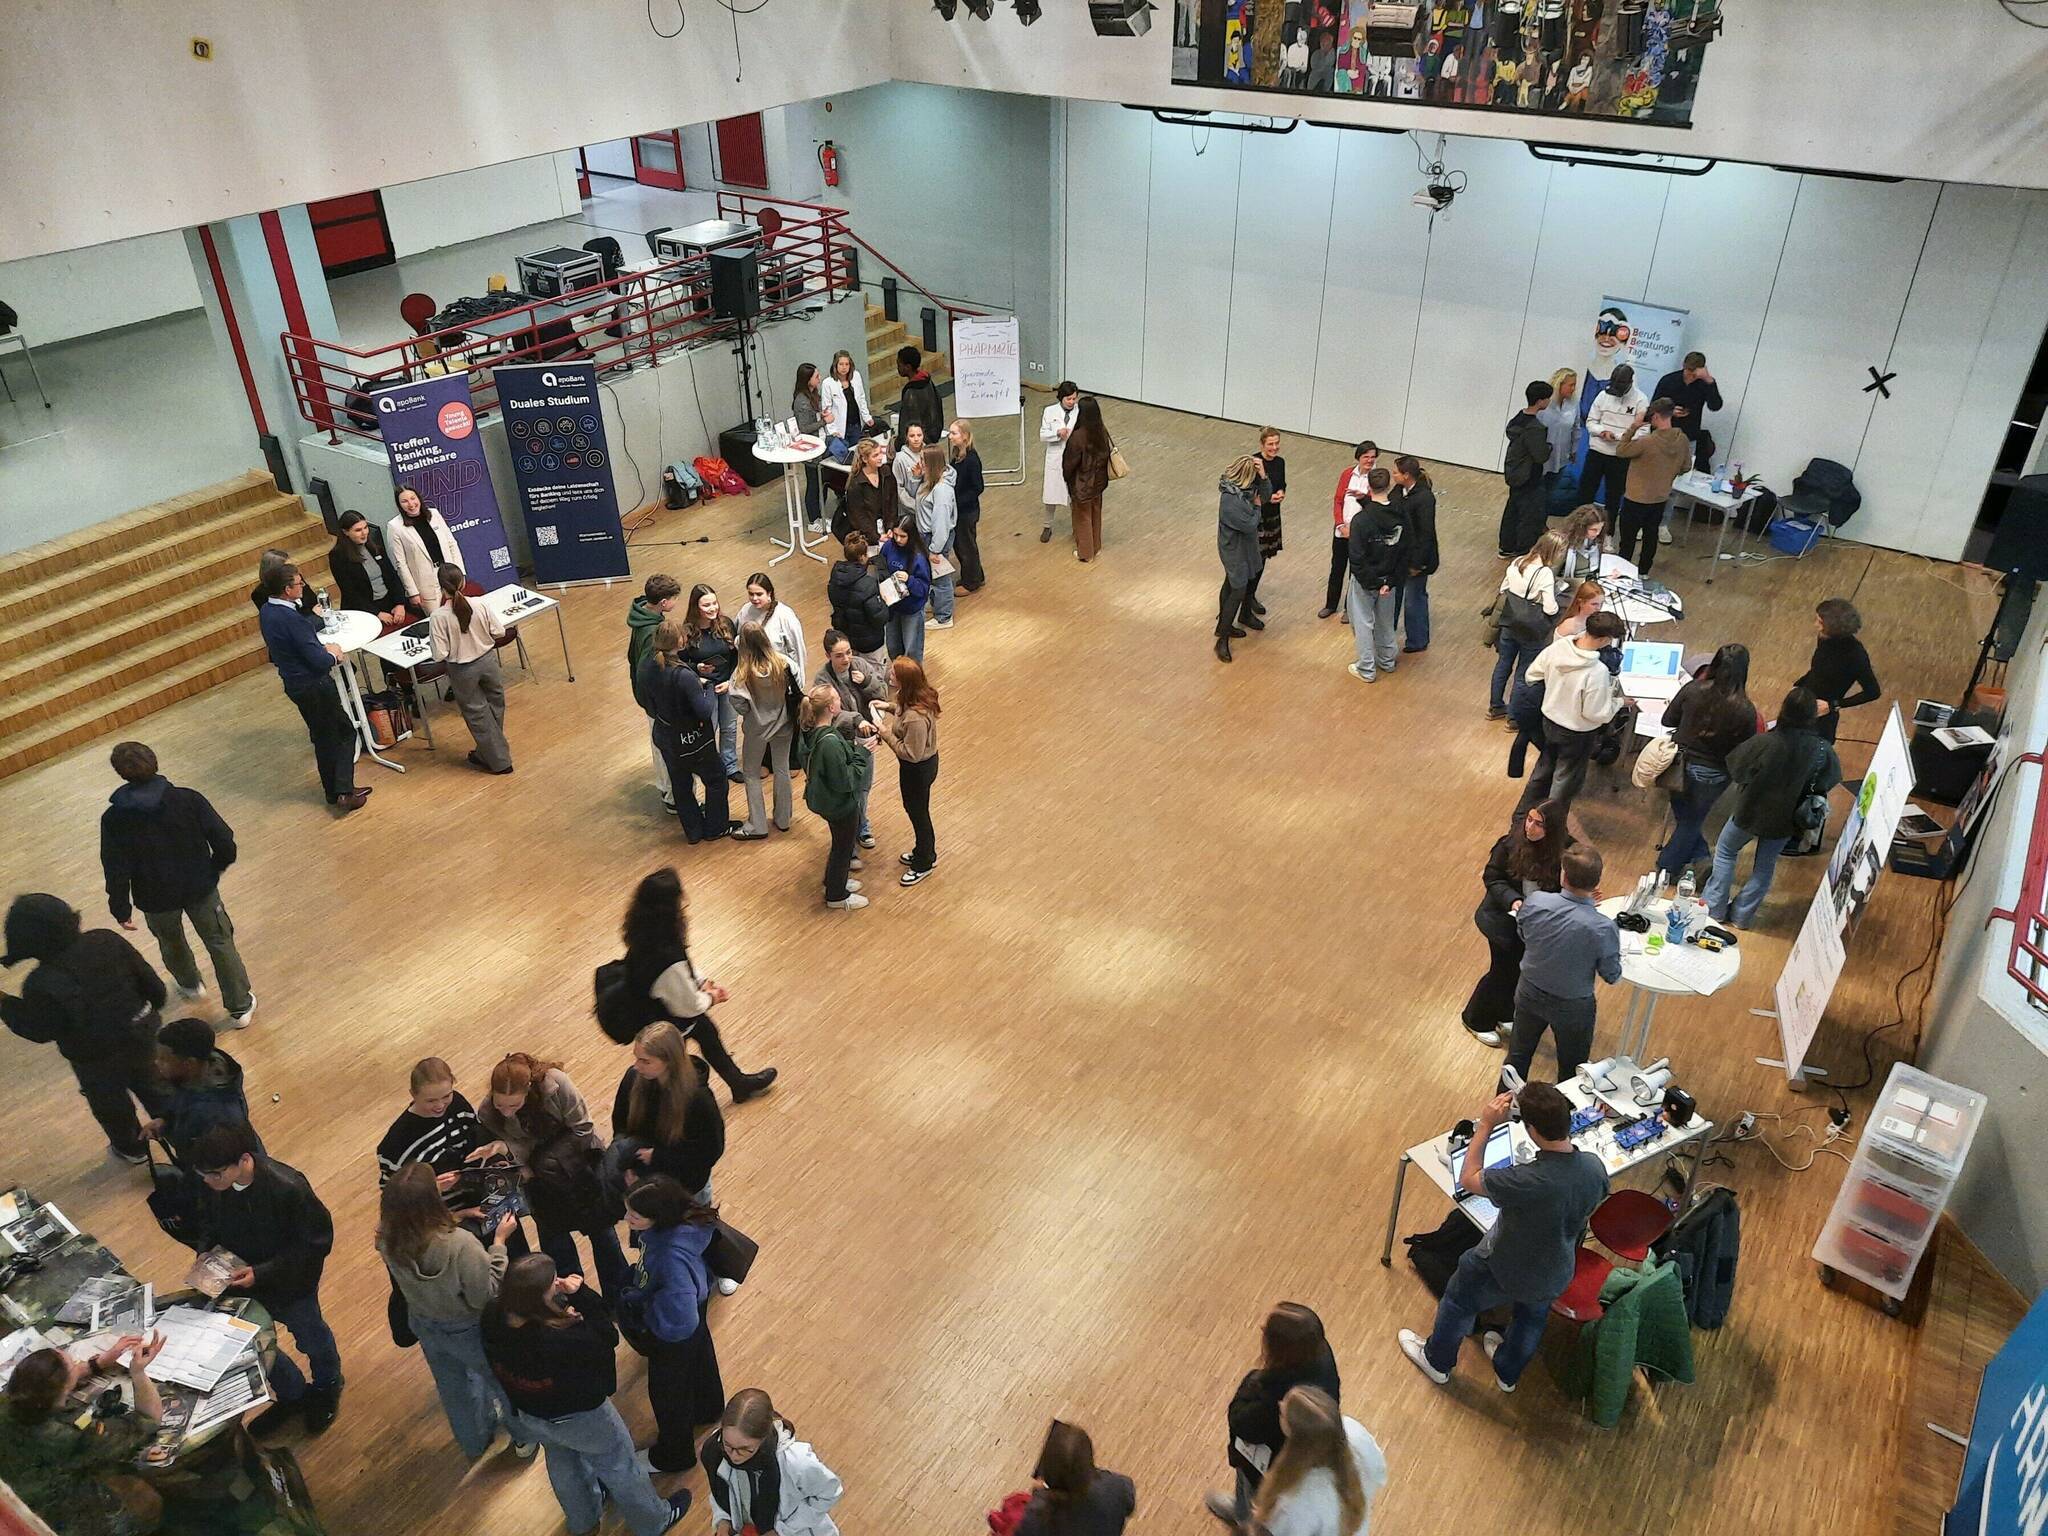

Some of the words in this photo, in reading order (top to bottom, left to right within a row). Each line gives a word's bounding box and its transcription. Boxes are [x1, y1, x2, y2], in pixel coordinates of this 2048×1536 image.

[1632, 328, 1661, 341] Berufs
[960, 340, 1016, 356] PHARMAZIE
[1628, 346, 1648, 359] Tage
[1630, 337, 1675, 354] Beratungs
[510, 398, 545, 409] Duales
[547, 395, 590, 406] Studium
[391, 436, 430, 452] Treffen
[395, 445, 442, 463] Banking,
[398, 451, 457, 473] Healthcare
[450, 518, 480, 533] ander
